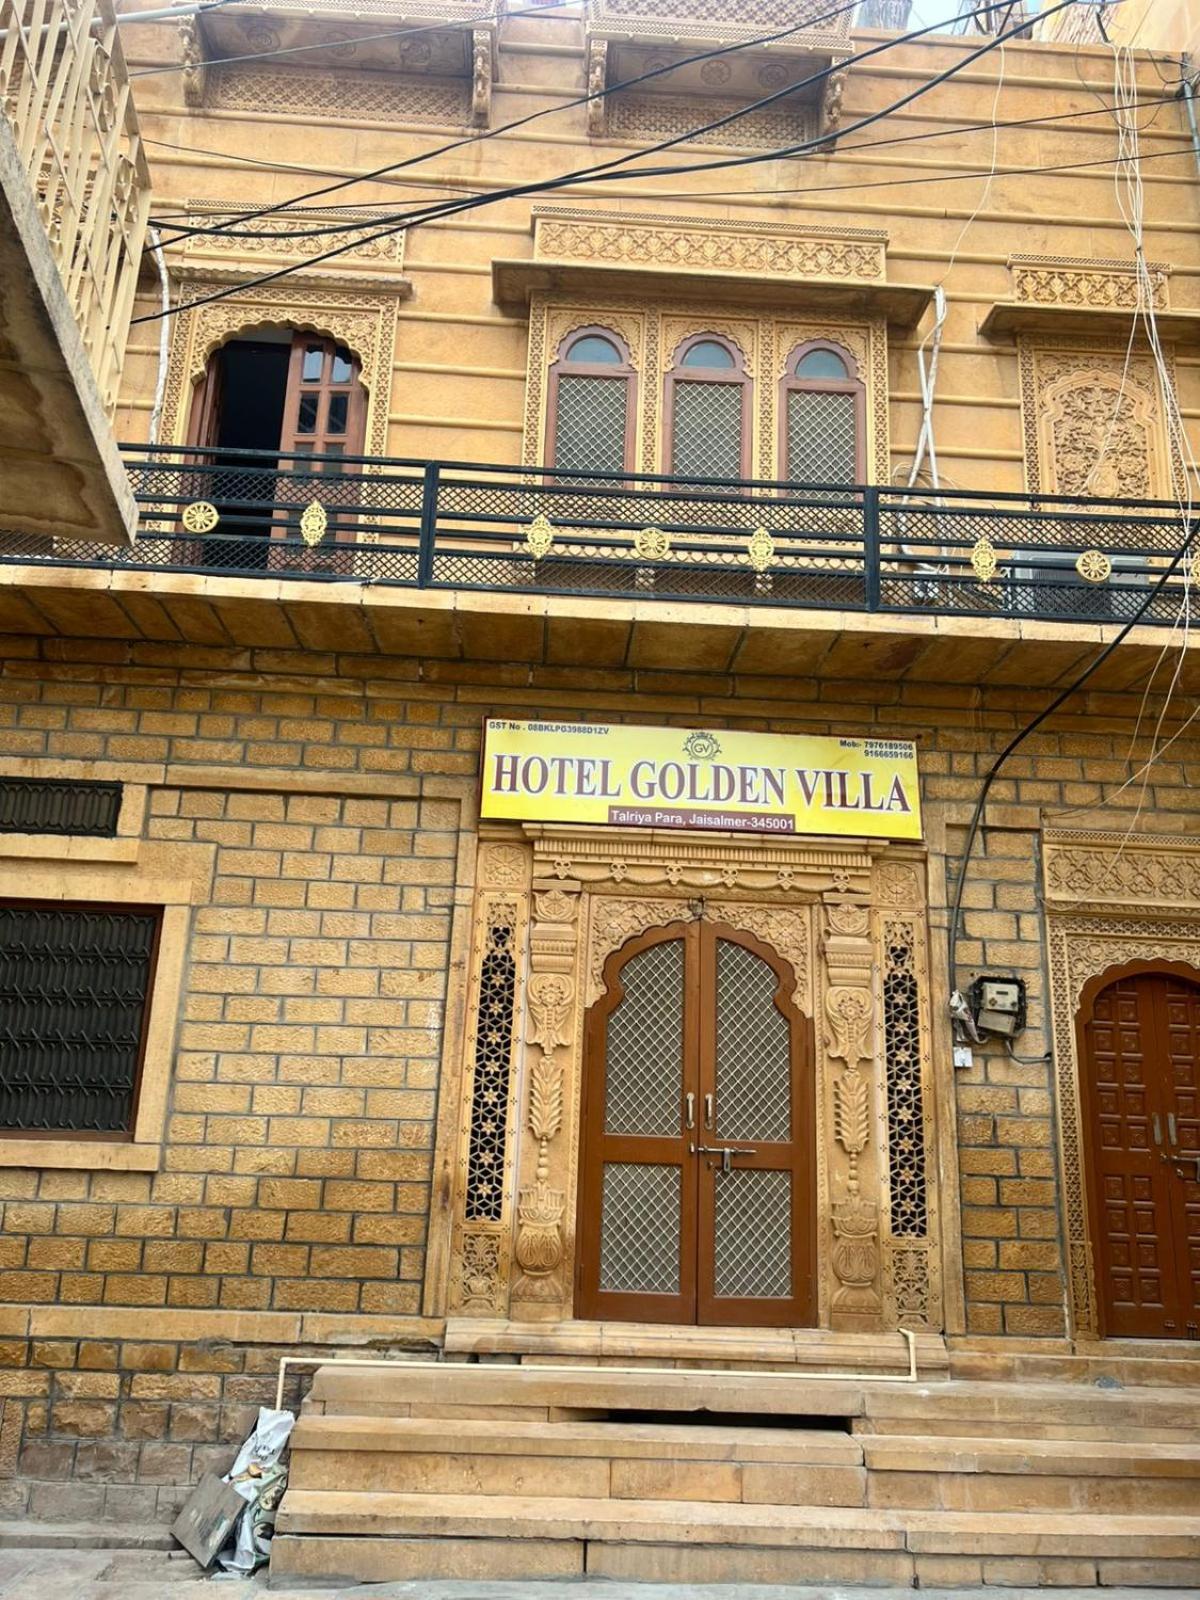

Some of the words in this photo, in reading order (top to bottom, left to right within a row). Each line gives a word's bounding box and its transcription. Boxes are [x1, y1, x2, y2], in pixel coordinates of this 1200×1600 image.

[489, 721, 506, 730] GST
[492, 754, 620, 797] HOTEL
[630, 761, 786, 803] GOLDEN
[795, 769, 911, 812] VILLA
[655, 812, 686, 826] Para,
[689, 814, 794, 829] Jaisalmer-345001
